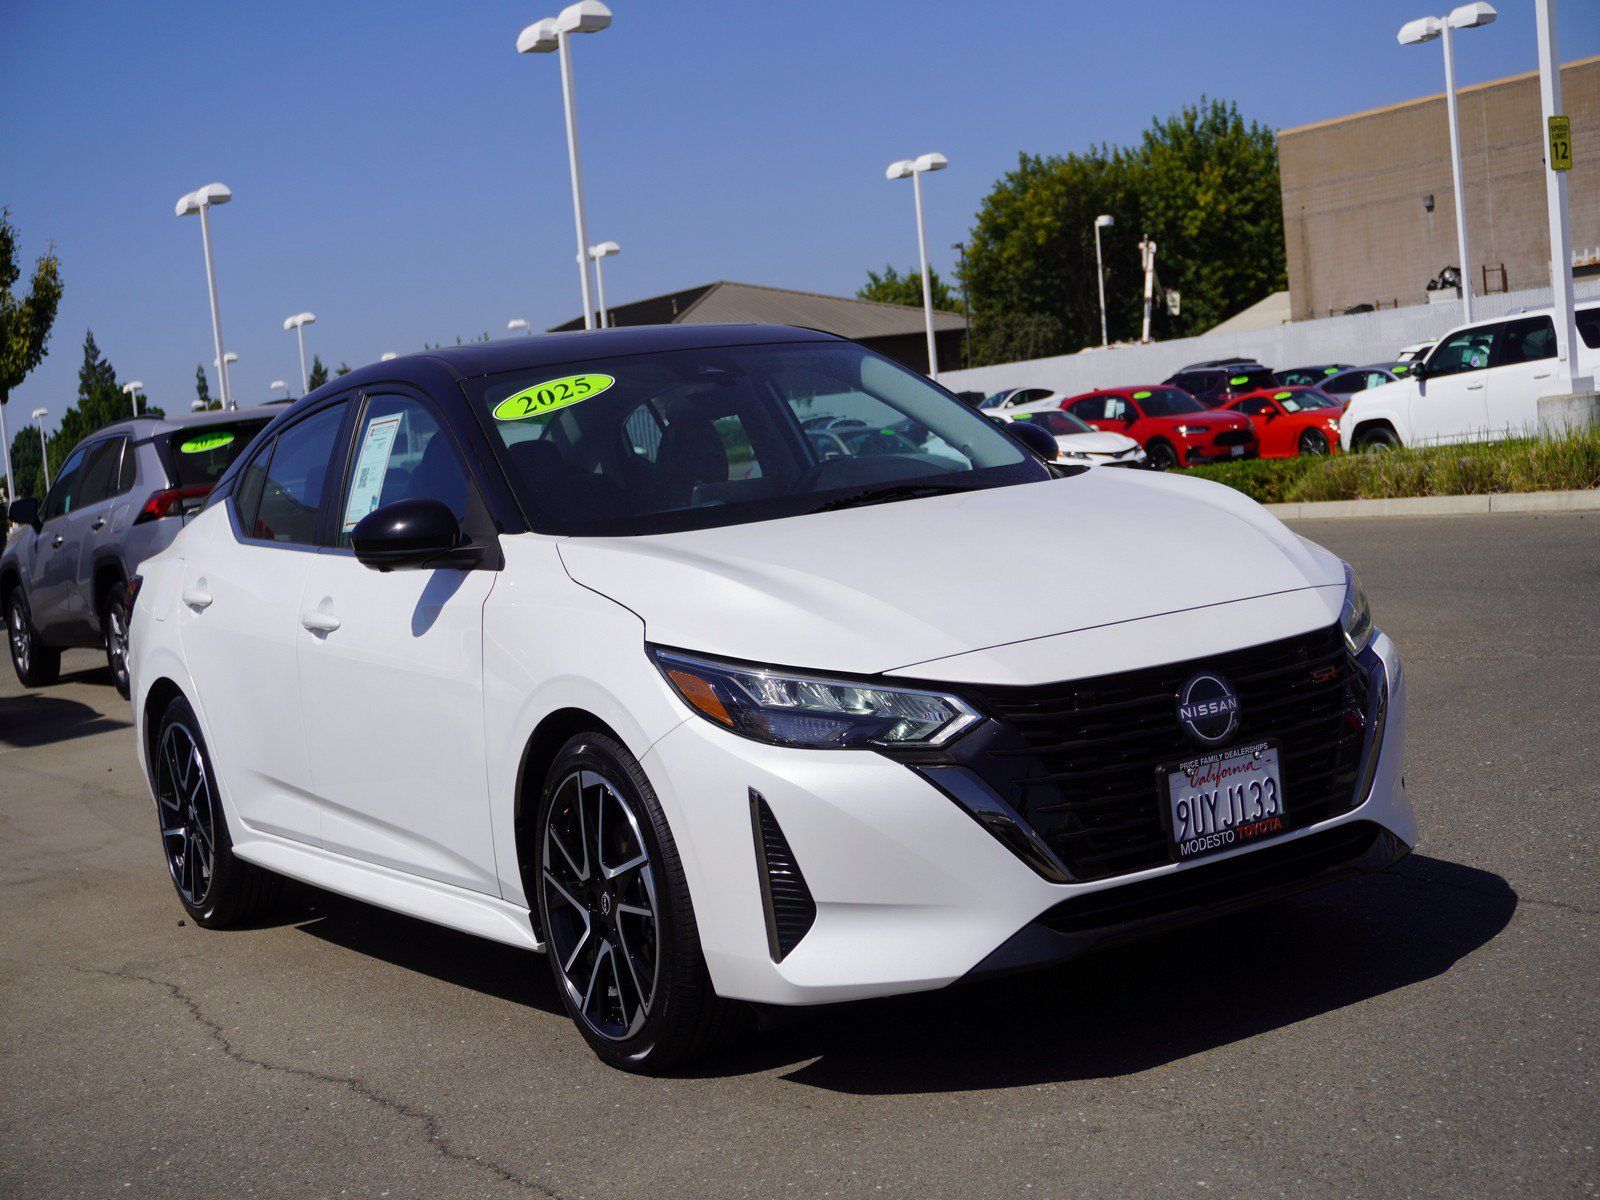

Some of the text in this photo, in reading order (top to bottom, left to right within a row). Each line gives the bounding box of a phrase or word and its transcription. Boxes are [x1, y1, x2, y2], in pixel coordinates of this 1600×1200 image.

[1552, 142, 1568, 160] 12
[517, 377, 591, 415] 2025
[1180, 698, 1237, 719] NISSAN
[1180, 742, 1268, 771] PRICE FAMILY DEALERSHIPS
[1190, 760, 1262, 788] California
[1176, 777, 1279, 840] 9UYJ133
[1180, 817, 1283, 856] MODESTO TOYOTA
